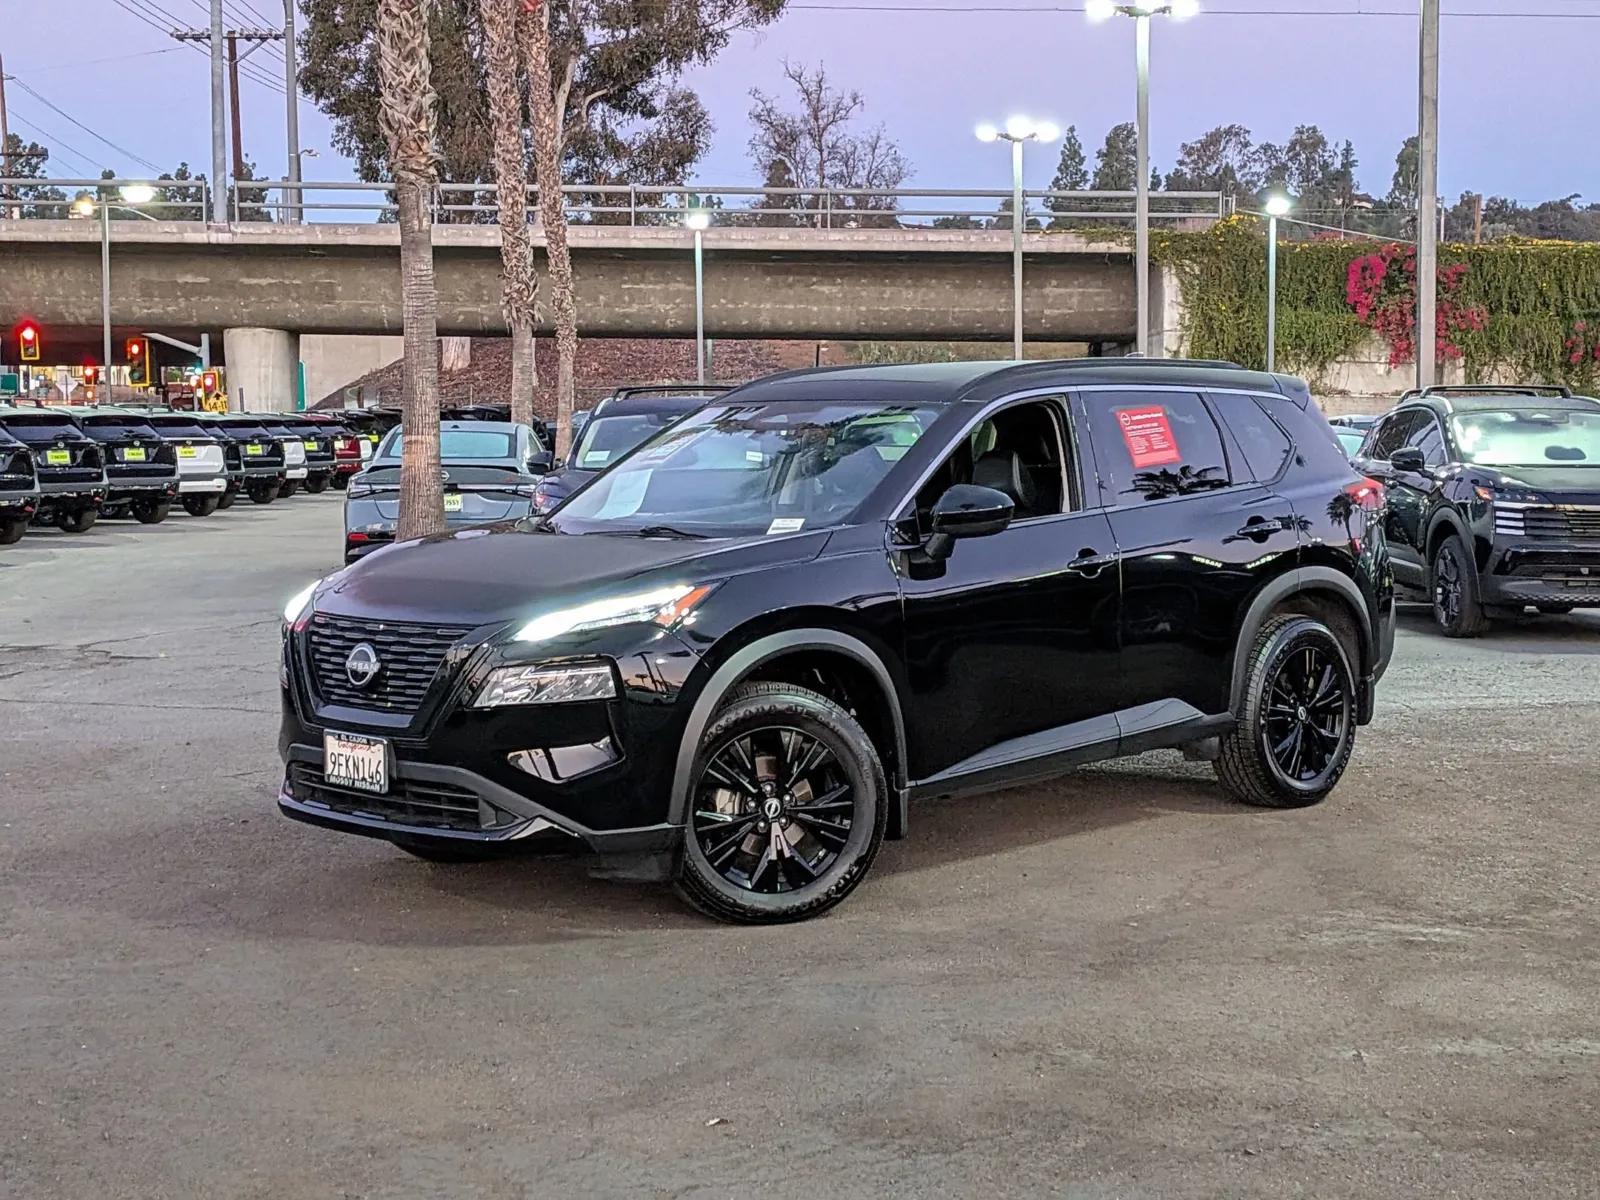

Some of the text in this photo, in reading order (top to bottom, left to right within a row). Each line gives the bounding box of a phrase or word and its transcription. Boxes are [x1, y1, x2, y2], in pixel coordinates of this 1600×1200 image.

[329, 751, 382, 785] 9FKN146
[329, 775, 380, 792] MOSSY NISSAN
